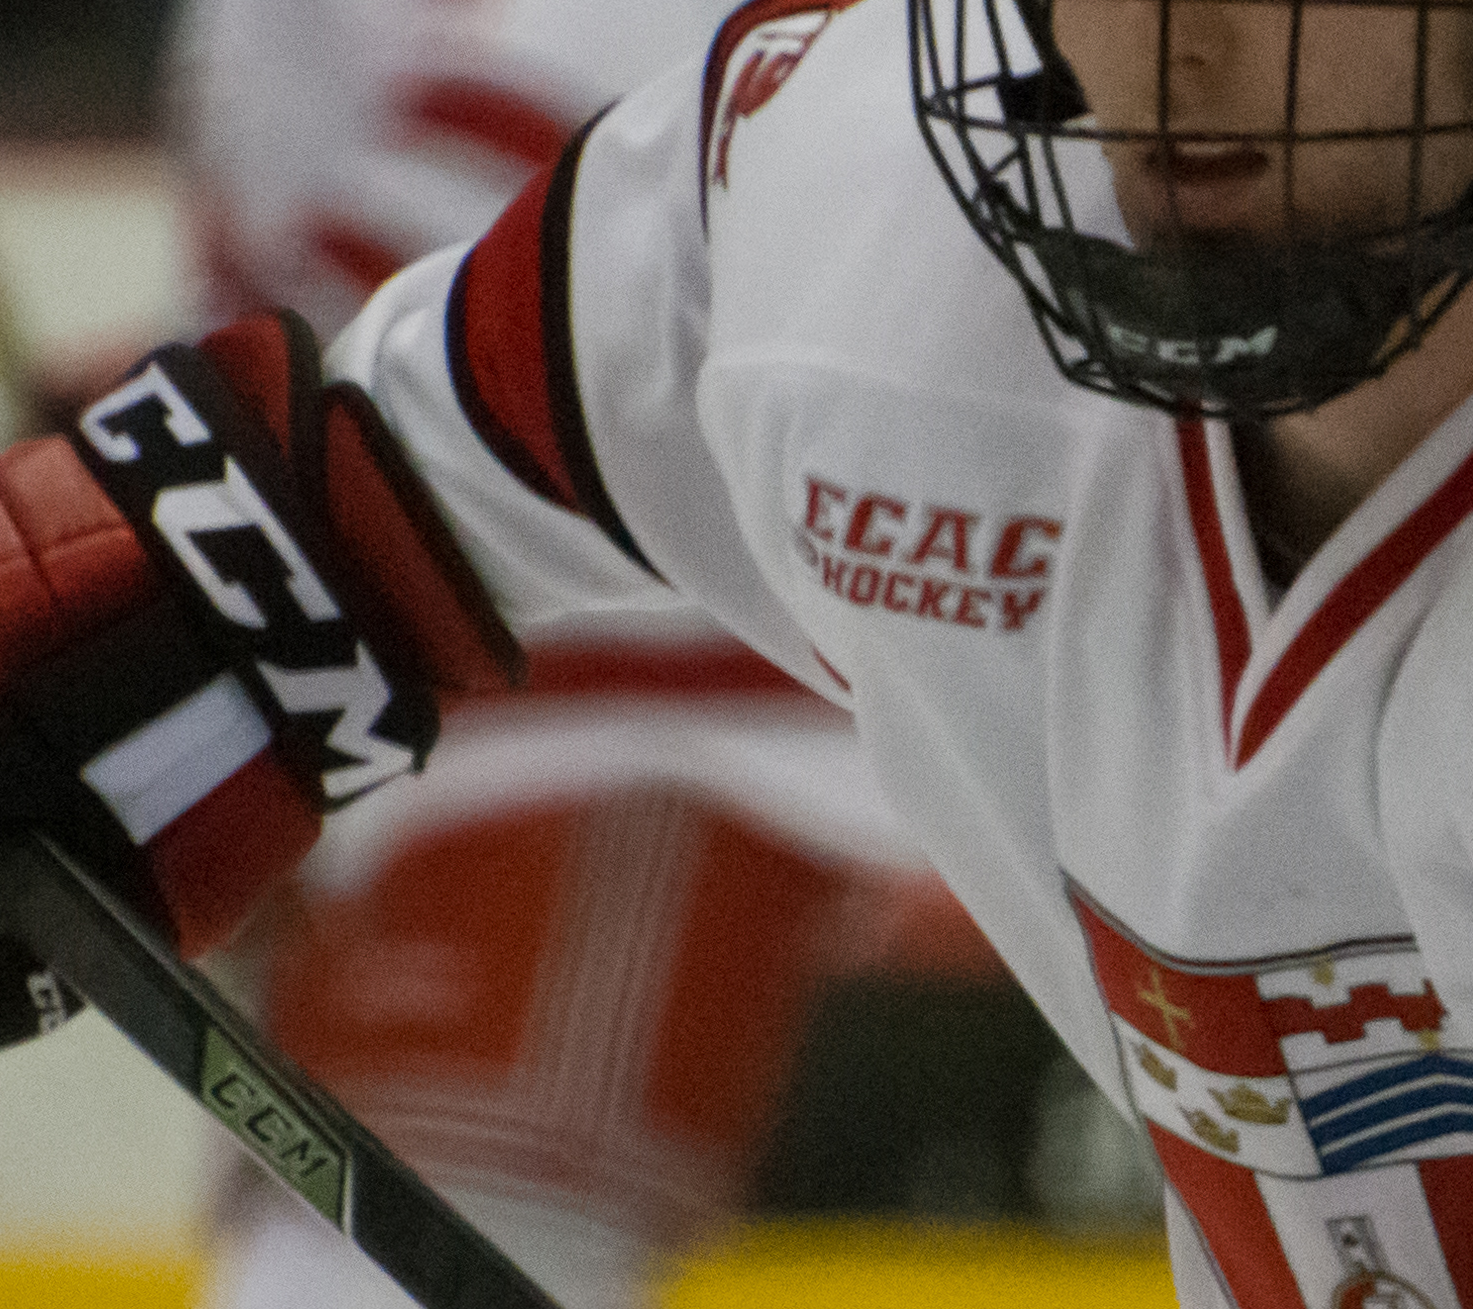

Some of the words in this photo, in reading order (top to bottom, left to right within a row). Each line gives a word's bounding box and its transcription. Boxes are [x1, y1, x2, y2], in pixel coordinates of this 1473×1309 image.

[803, 473, 1063, 580] ECAC
[79, 360, 416, 801] CCM
[821, 553, 1048, 632] HOCKEY
[210, 1072, 327, 1179] CCM
